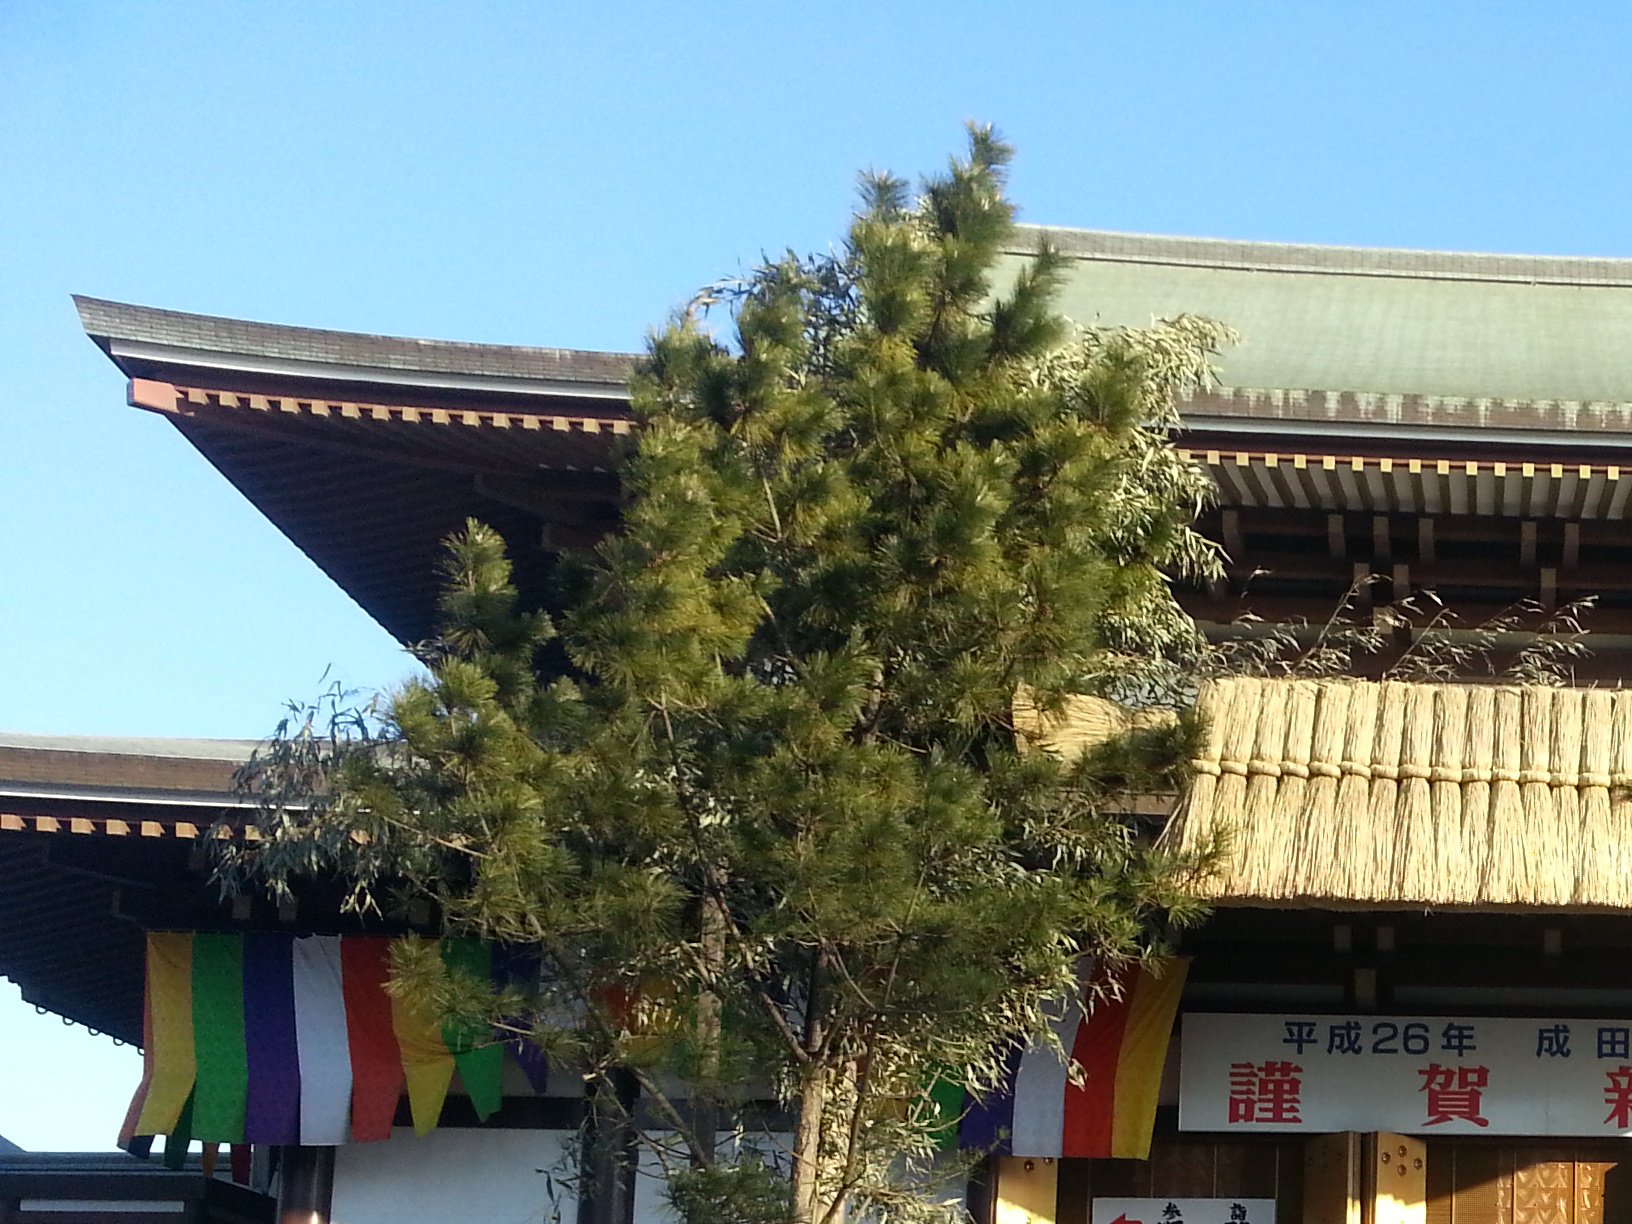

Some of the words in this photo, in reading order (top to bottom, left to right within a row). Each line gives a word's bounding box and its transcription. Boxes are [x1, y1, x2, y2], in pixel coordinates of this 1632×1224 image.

[1282, 1020, 1477, 1057] 平成26年
[1162, 1202, 1248, 1221] 参詣
